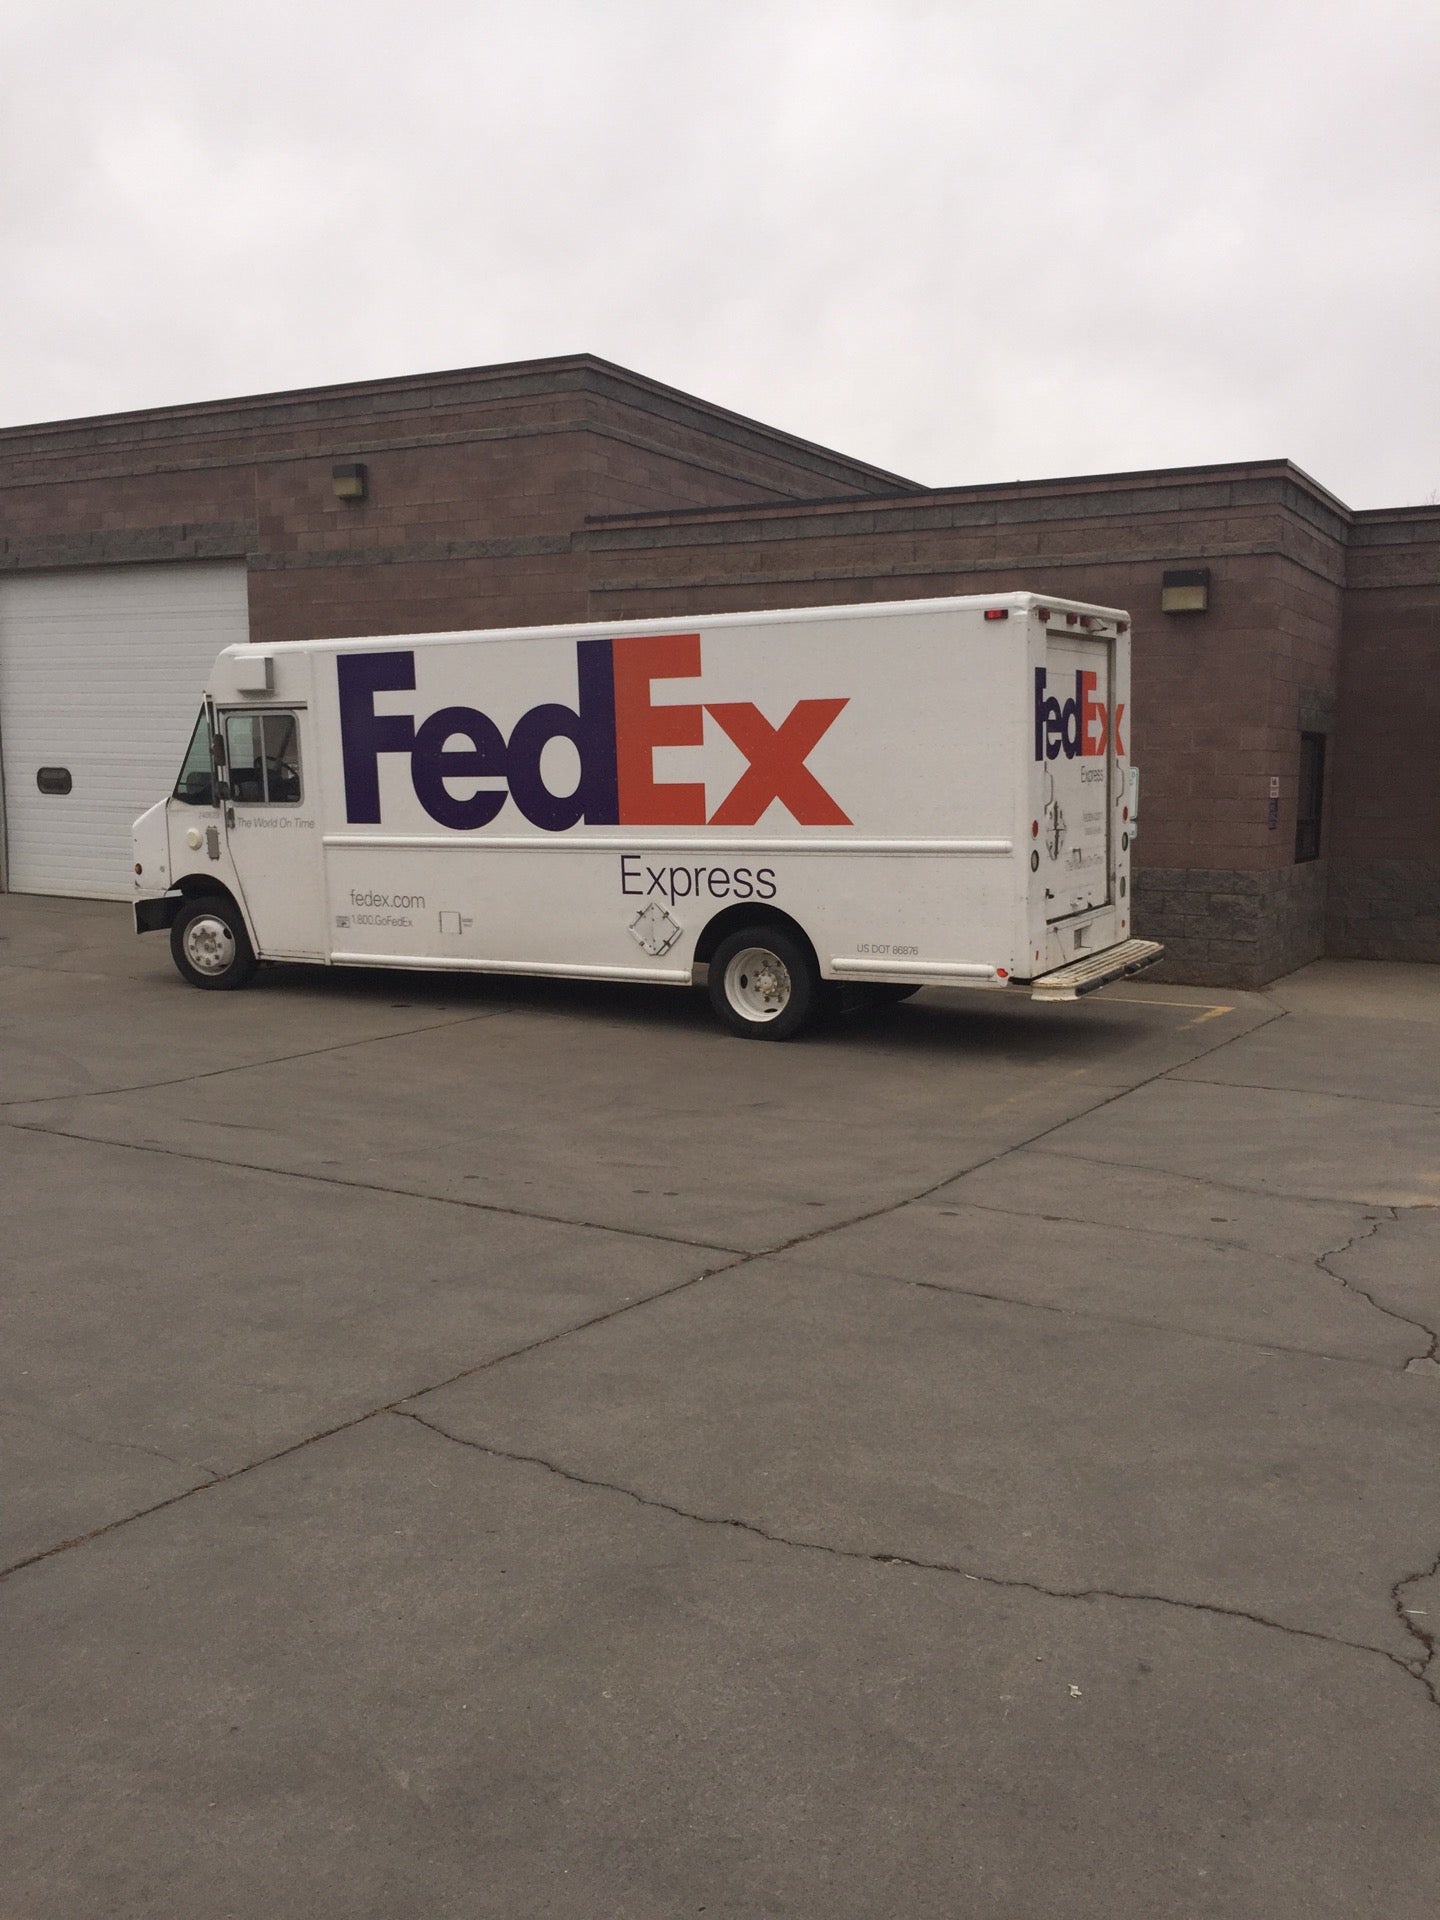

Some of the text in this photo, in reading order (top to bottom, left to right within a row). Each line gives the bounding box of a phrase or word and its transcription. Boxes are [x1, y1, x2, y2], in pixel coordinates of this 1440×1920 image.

[1035, 667, 1125, 761] FedEx
[337, 634, 854, 831] FedEx
[237, 817, 315, 829] The World On Time
[621, 855, 777, 906] Express
[350, 889, 425, 908] fedex.com
[856, 944, 919, 956] US DOT 86876
